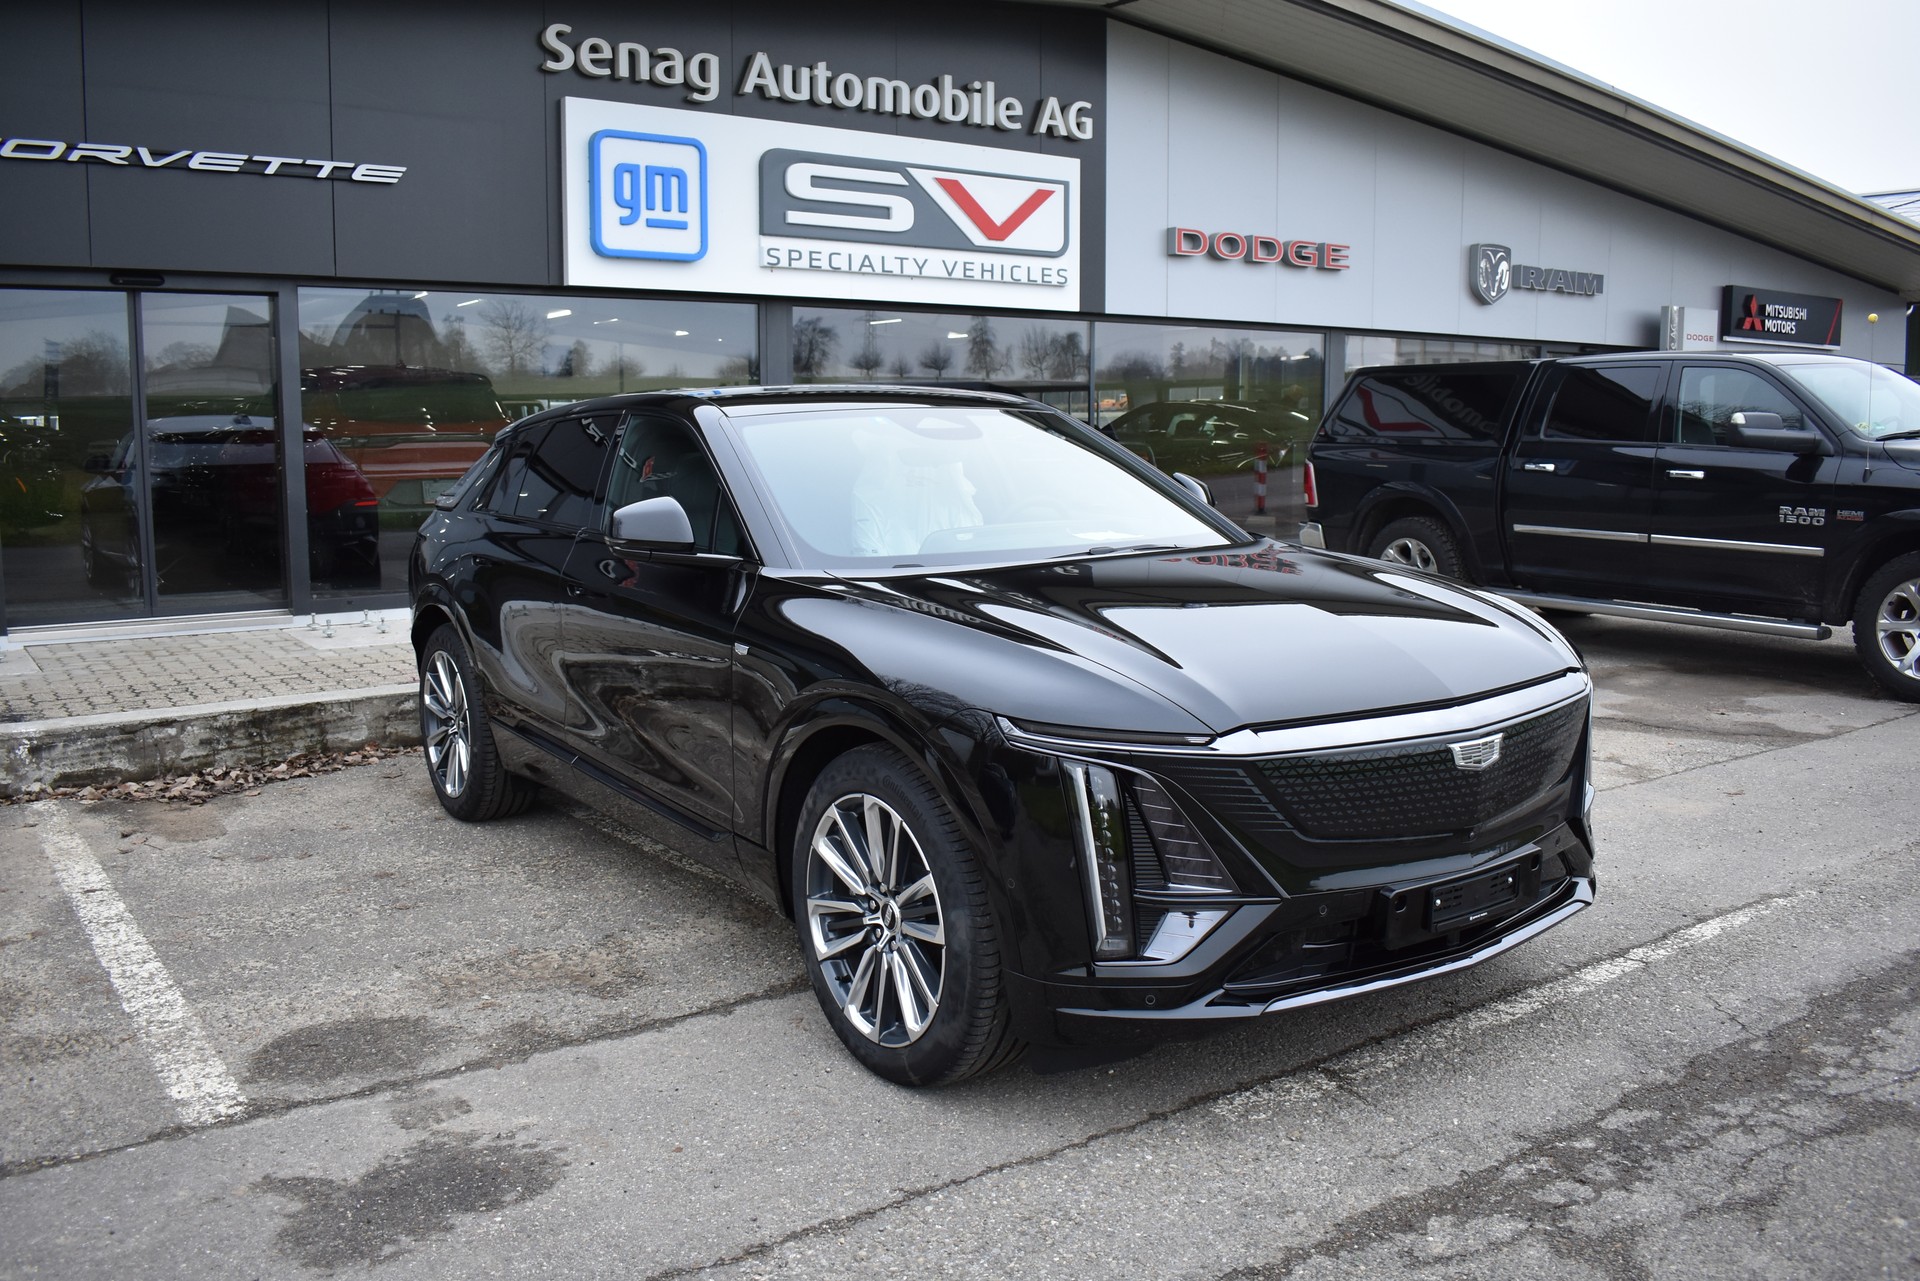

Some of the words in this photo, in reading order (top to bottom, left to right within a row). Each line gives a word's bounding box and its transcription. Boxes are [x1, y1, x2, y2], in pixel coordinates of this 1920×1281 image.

[541, 23, 720, 101] Senag
[740, 51, 1024, 130] Automobile
[1034, 97, 1094, 140] AG
[0, 138, 407, 184] ORVETTE
[613, 162, 689, 230] gm
[765, 246, 928, 276] SPECIALTY
[941, 259, 1069, 286] VEHICLES
[1167, 226, 1351, 271] DODGE
[1512, 263, 1604, 296] RAM
[1764, 319, 1796, 334] MOTORS
[1765, 303, 1807, 320] MITSUBISHI
[1686, 333, 1715, 342] DODGE
[1779, 505, 1826, 517] RAM
[1779, 514, 1825, 526] 1500
[882, 774, 923, 821] Continental
